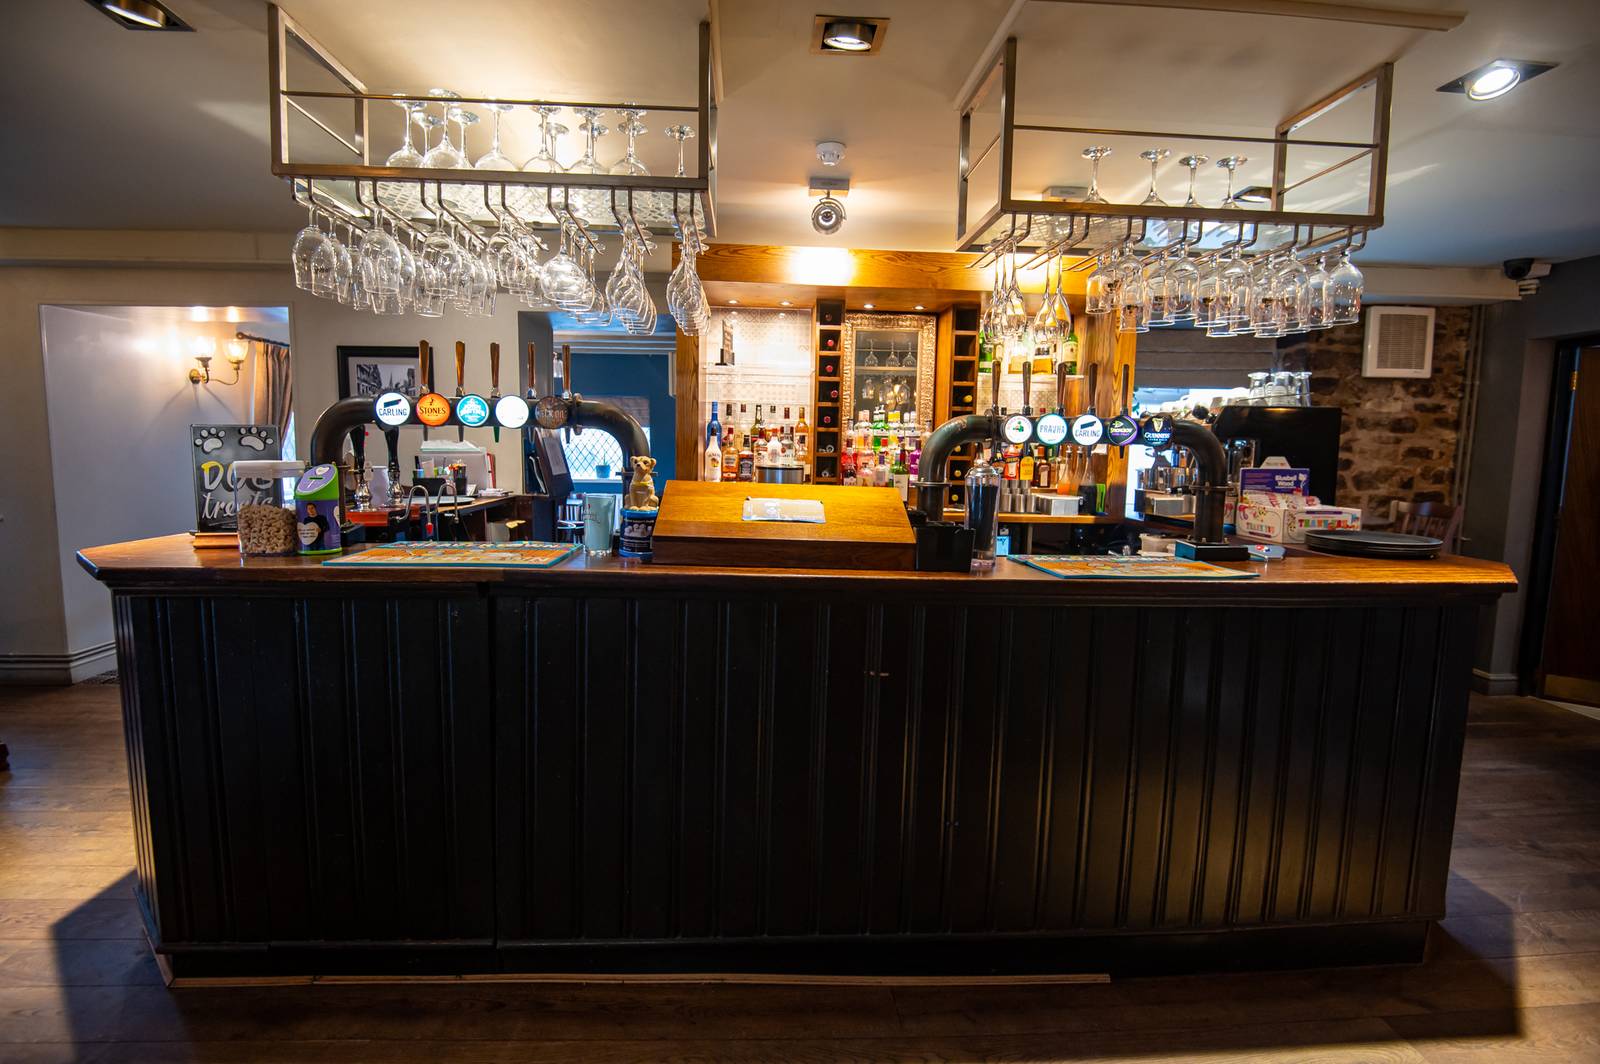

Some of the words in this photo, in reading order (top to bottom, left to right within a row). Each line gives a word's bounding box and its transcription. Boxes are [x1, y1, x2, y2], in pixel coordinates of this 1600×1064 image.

[379, 408, 407, 416] CARLING
[1040, 425, 1065, 433] PRAVHA
[1075, 429, 1101, 437] CARLING
[1298, 519, 1328, 529] THANK
